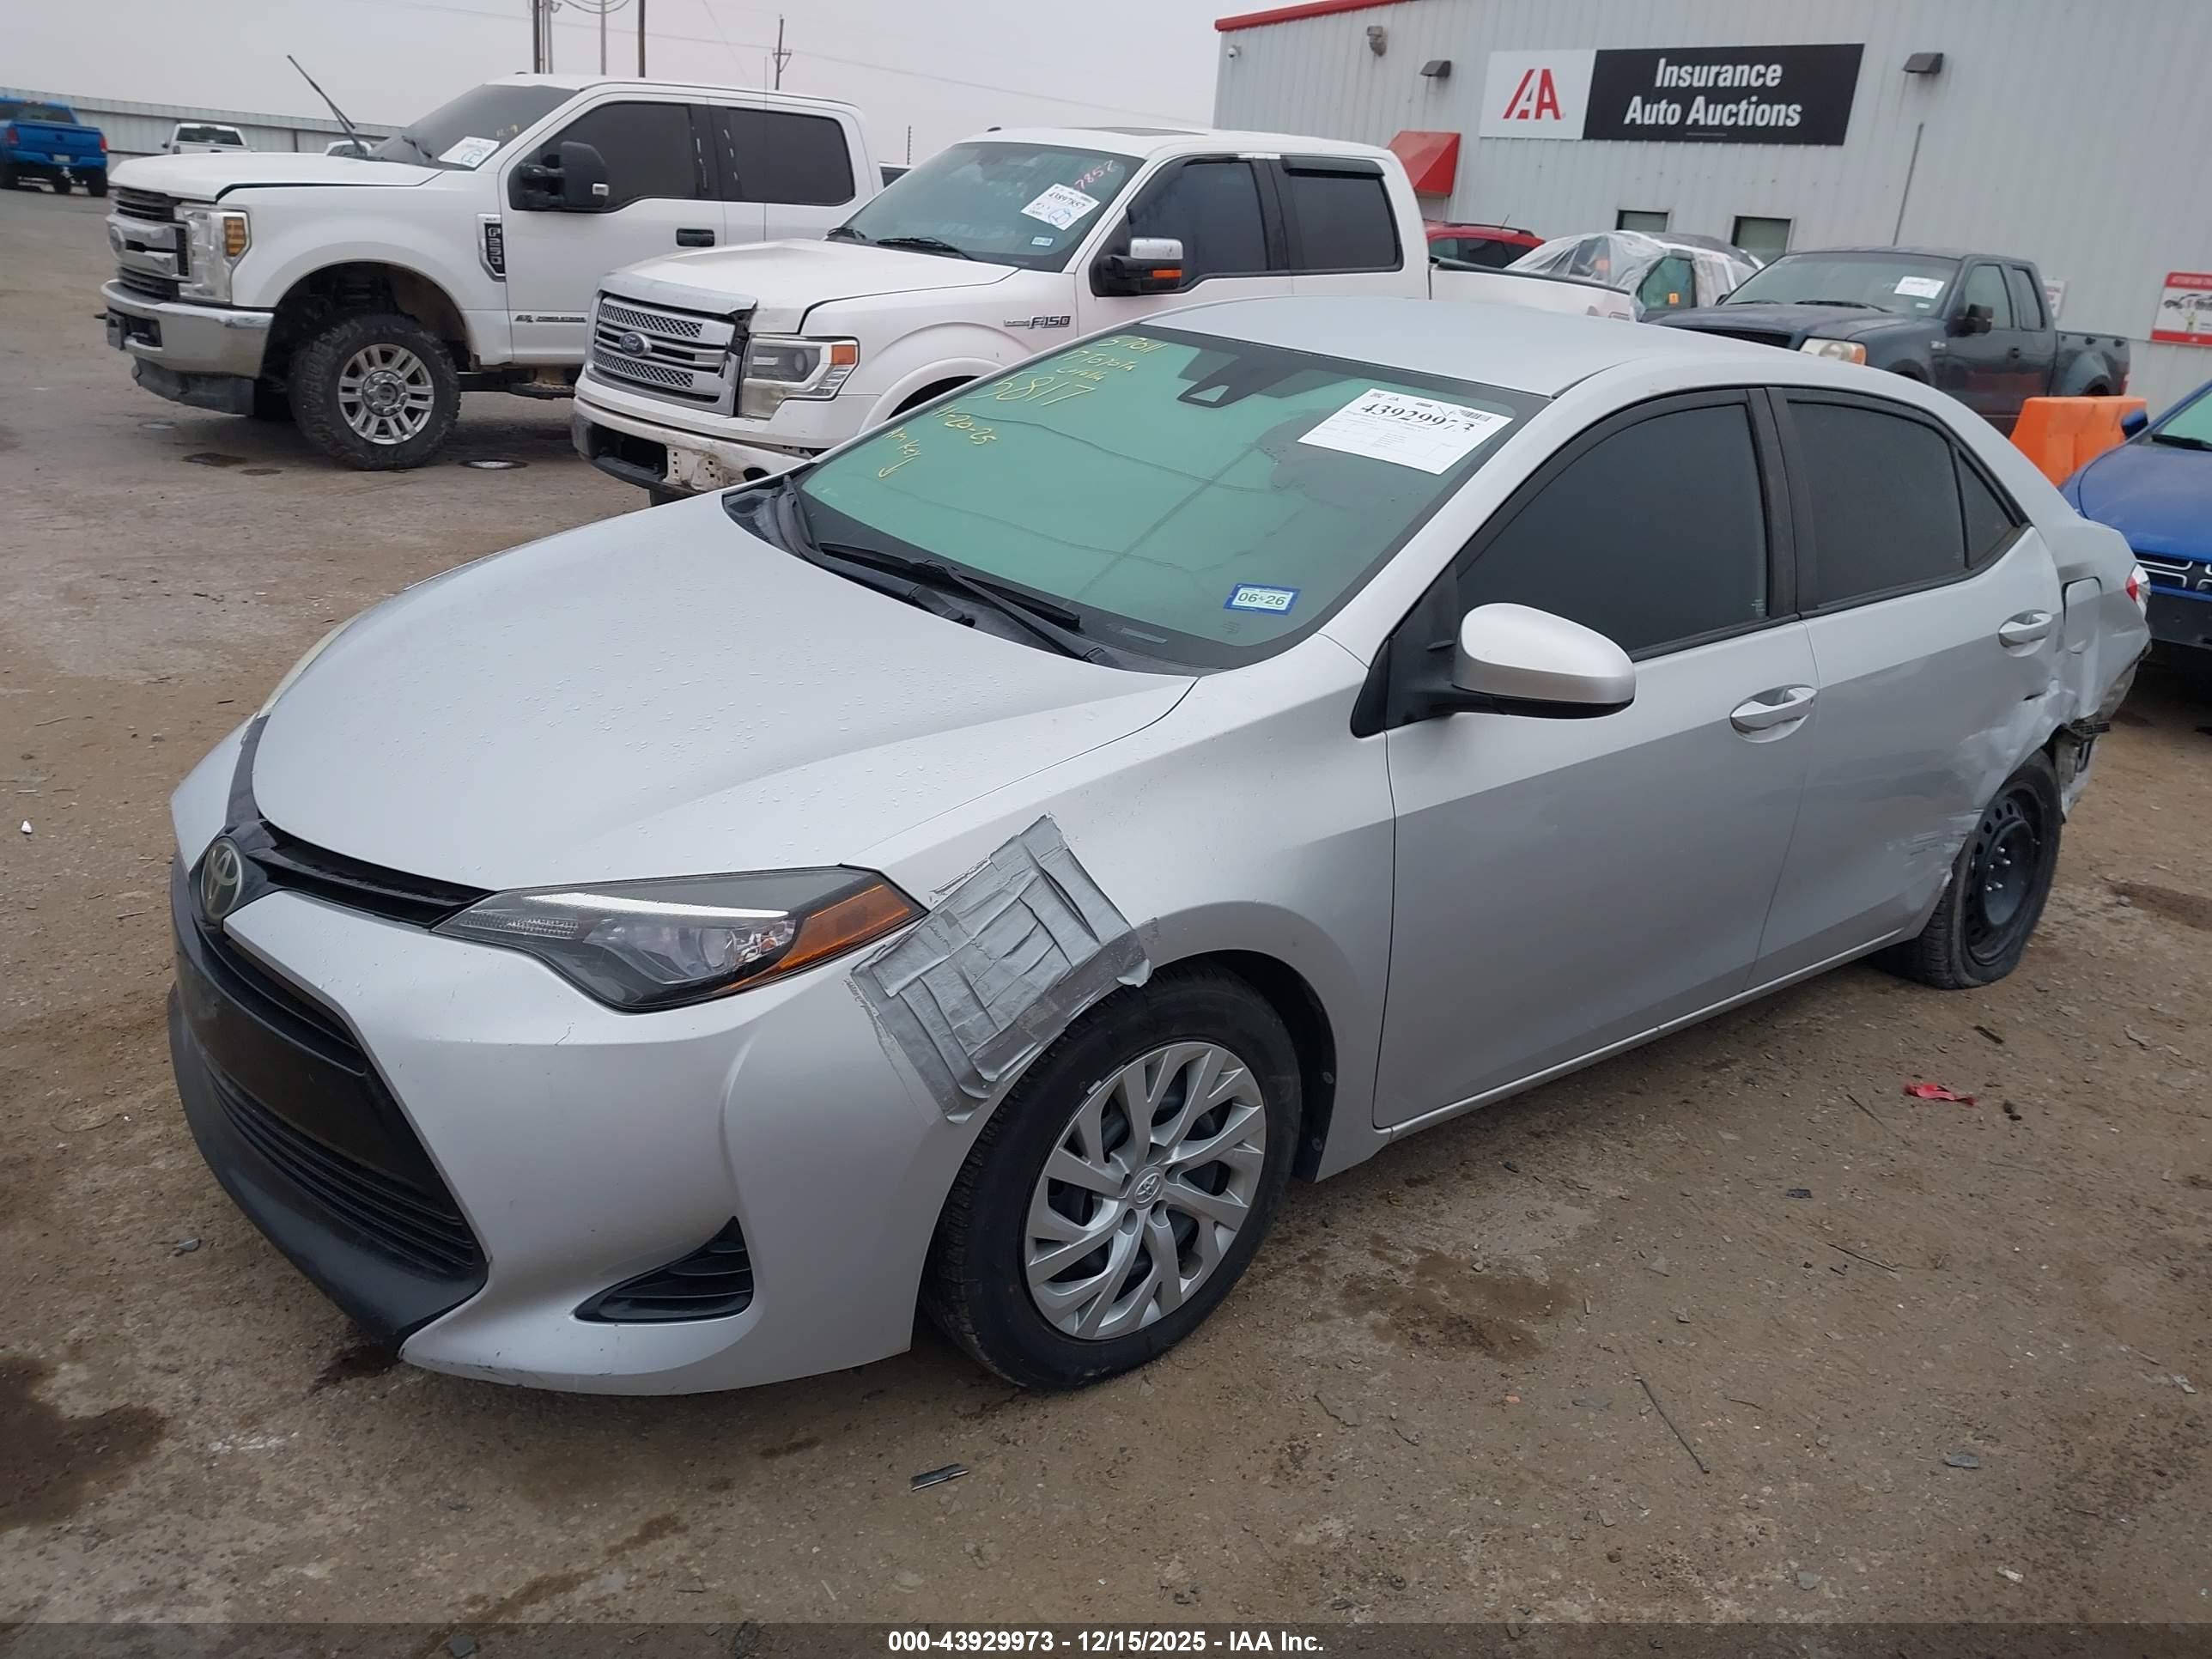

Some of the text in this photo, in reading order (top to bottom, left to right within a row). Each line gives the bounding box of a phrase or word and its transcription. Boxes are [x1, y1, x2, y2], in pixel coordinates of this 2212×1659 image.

[1656, 58, 1783, 88] Insurance
[1624, 96, 1802, 127] Auto Auctions
